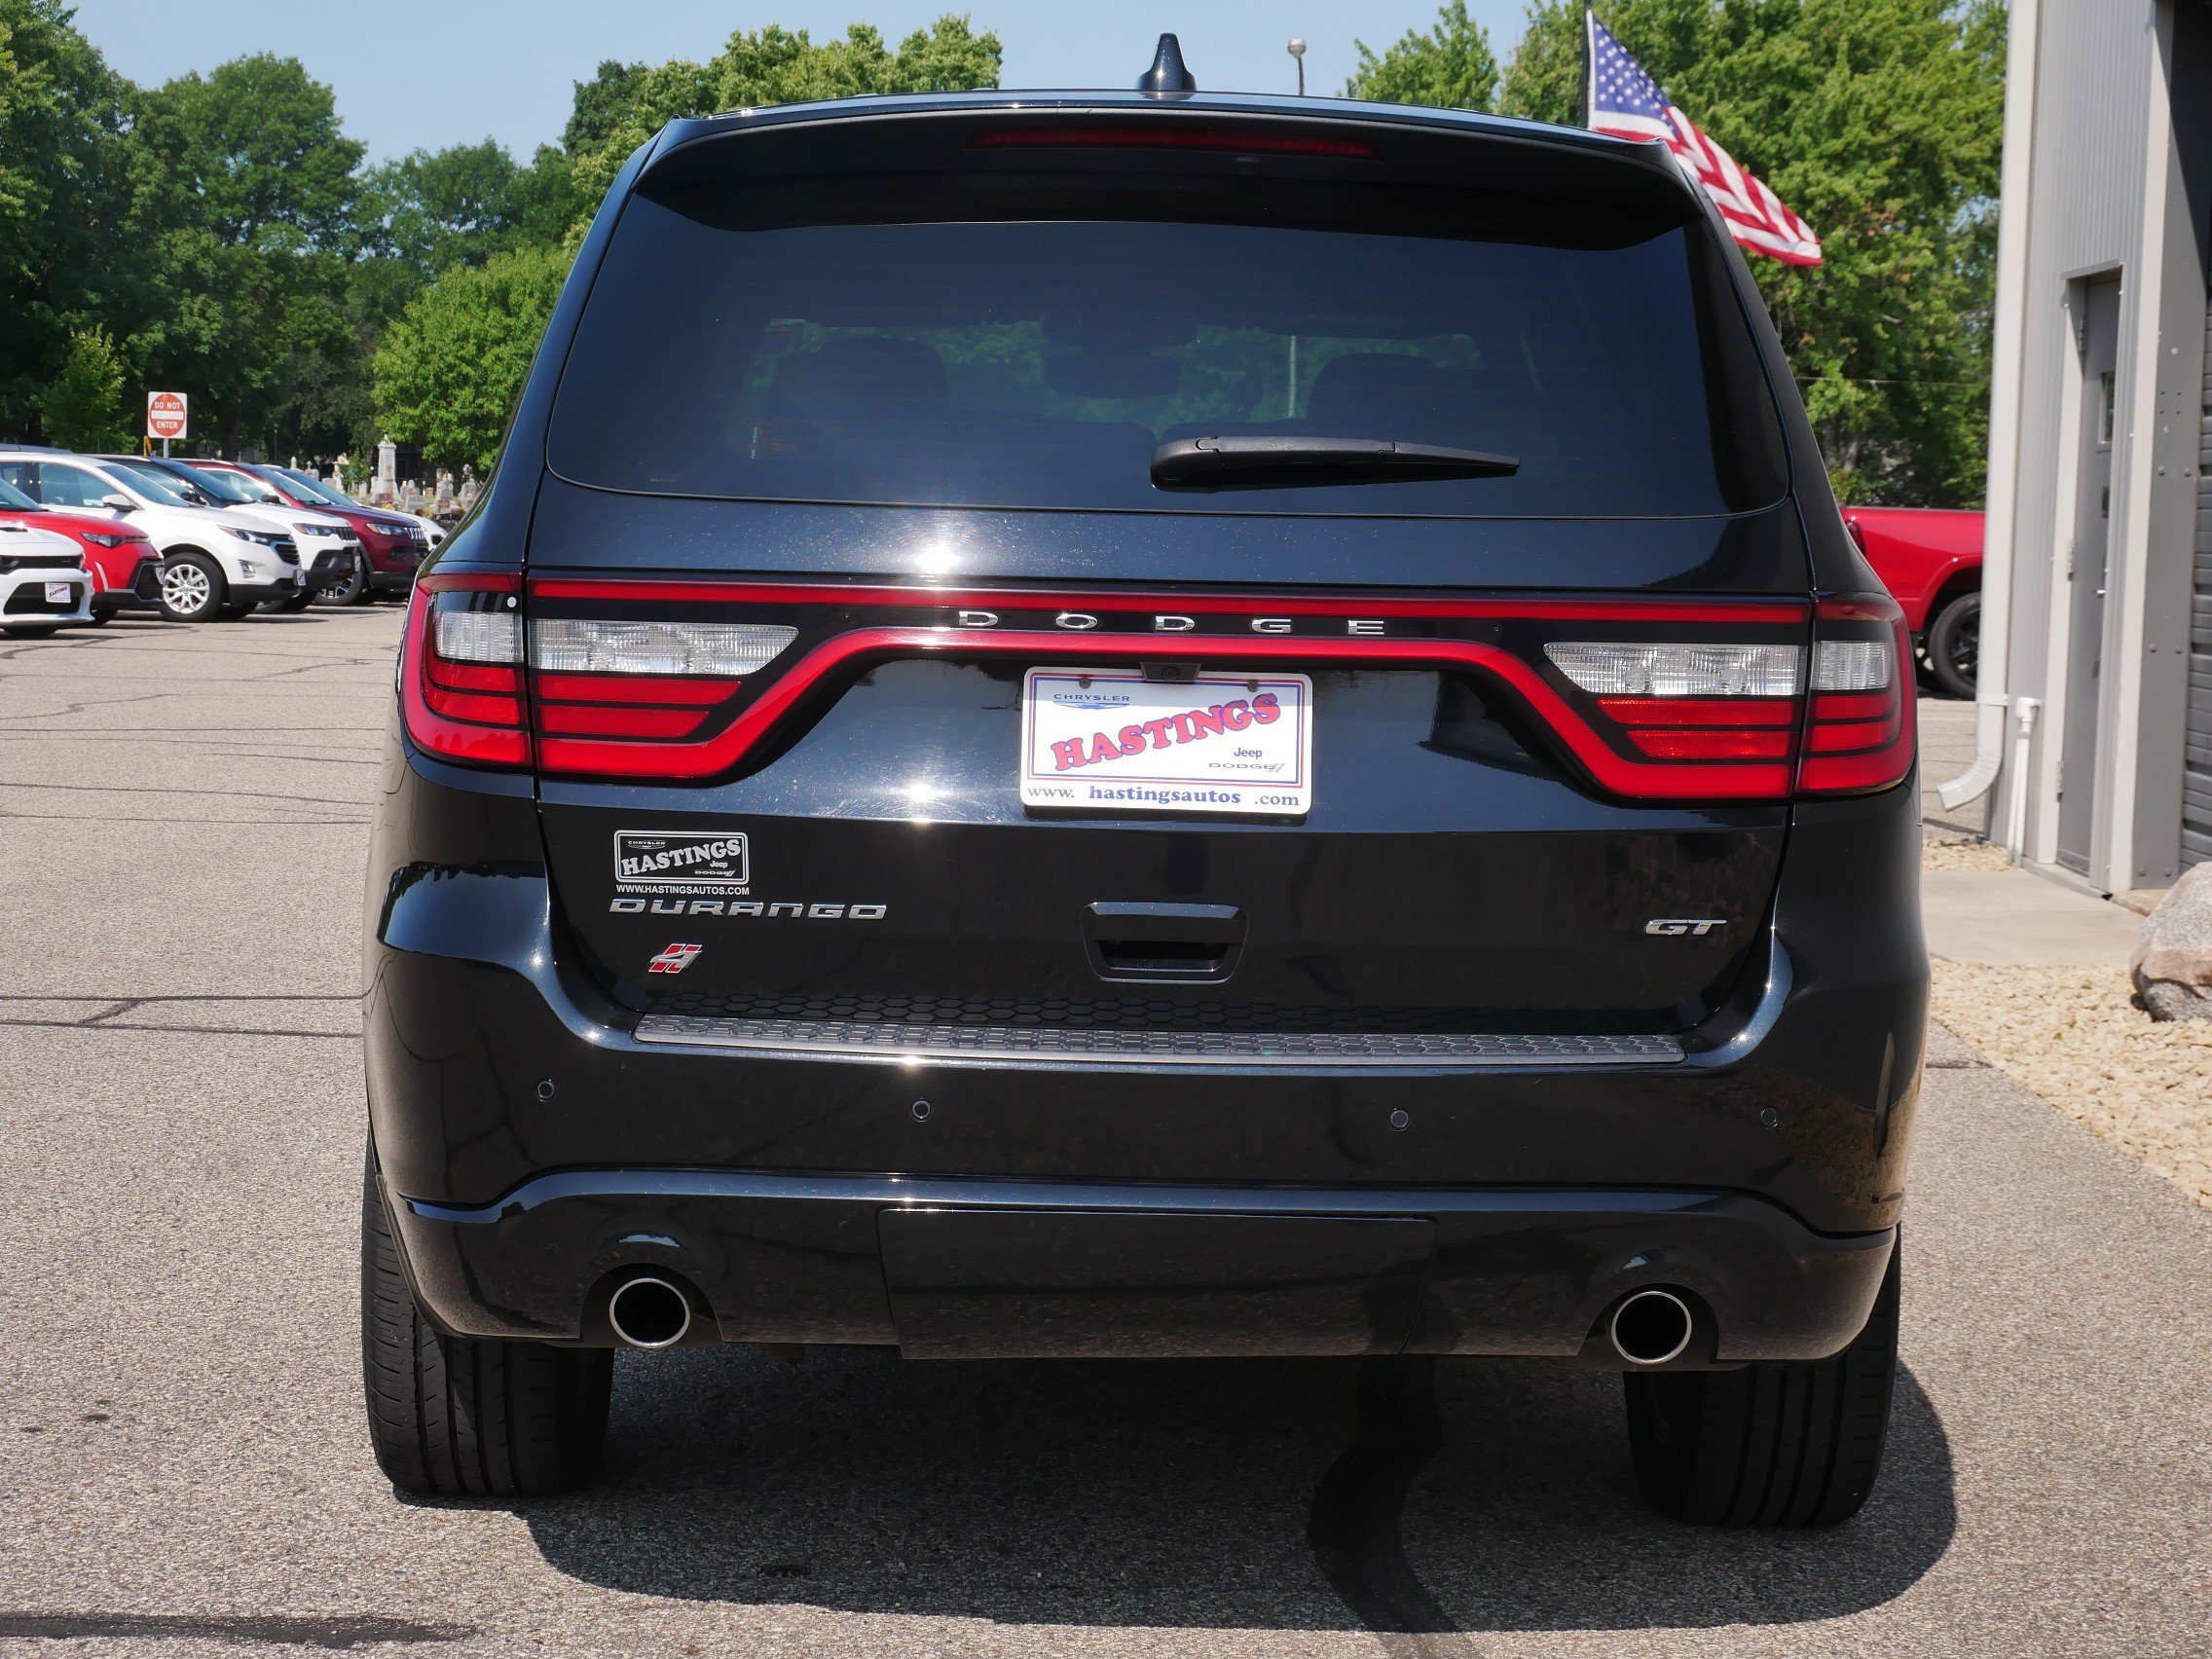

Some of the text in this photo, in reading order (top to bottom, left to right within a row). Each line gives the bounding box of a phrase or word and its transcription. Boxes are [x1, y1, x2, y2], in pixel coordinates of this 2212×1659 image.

[166, 401, 181, 410] NOT
[156, 421, 178, 429] ENTER
[958, 610, 1384, 636] DODGE
[1052, 693, 1130, 702] CHRYSLER
[1050, 692, 1281, 771] HASTINGS
[1233, 747, 1263, 759] Jeep
[1027, 785, 1300, 806] www. hastingsautos .com
[620, 838, 741, 875] HASTINGS
[710, 860, 728, 868] Jeep
[616, 884, 750, 895] WWW.HASTINGSAUTOS.COM
[608, 898, 887, 920] DURANGO
[1644, 919, 1727, 935] GT
